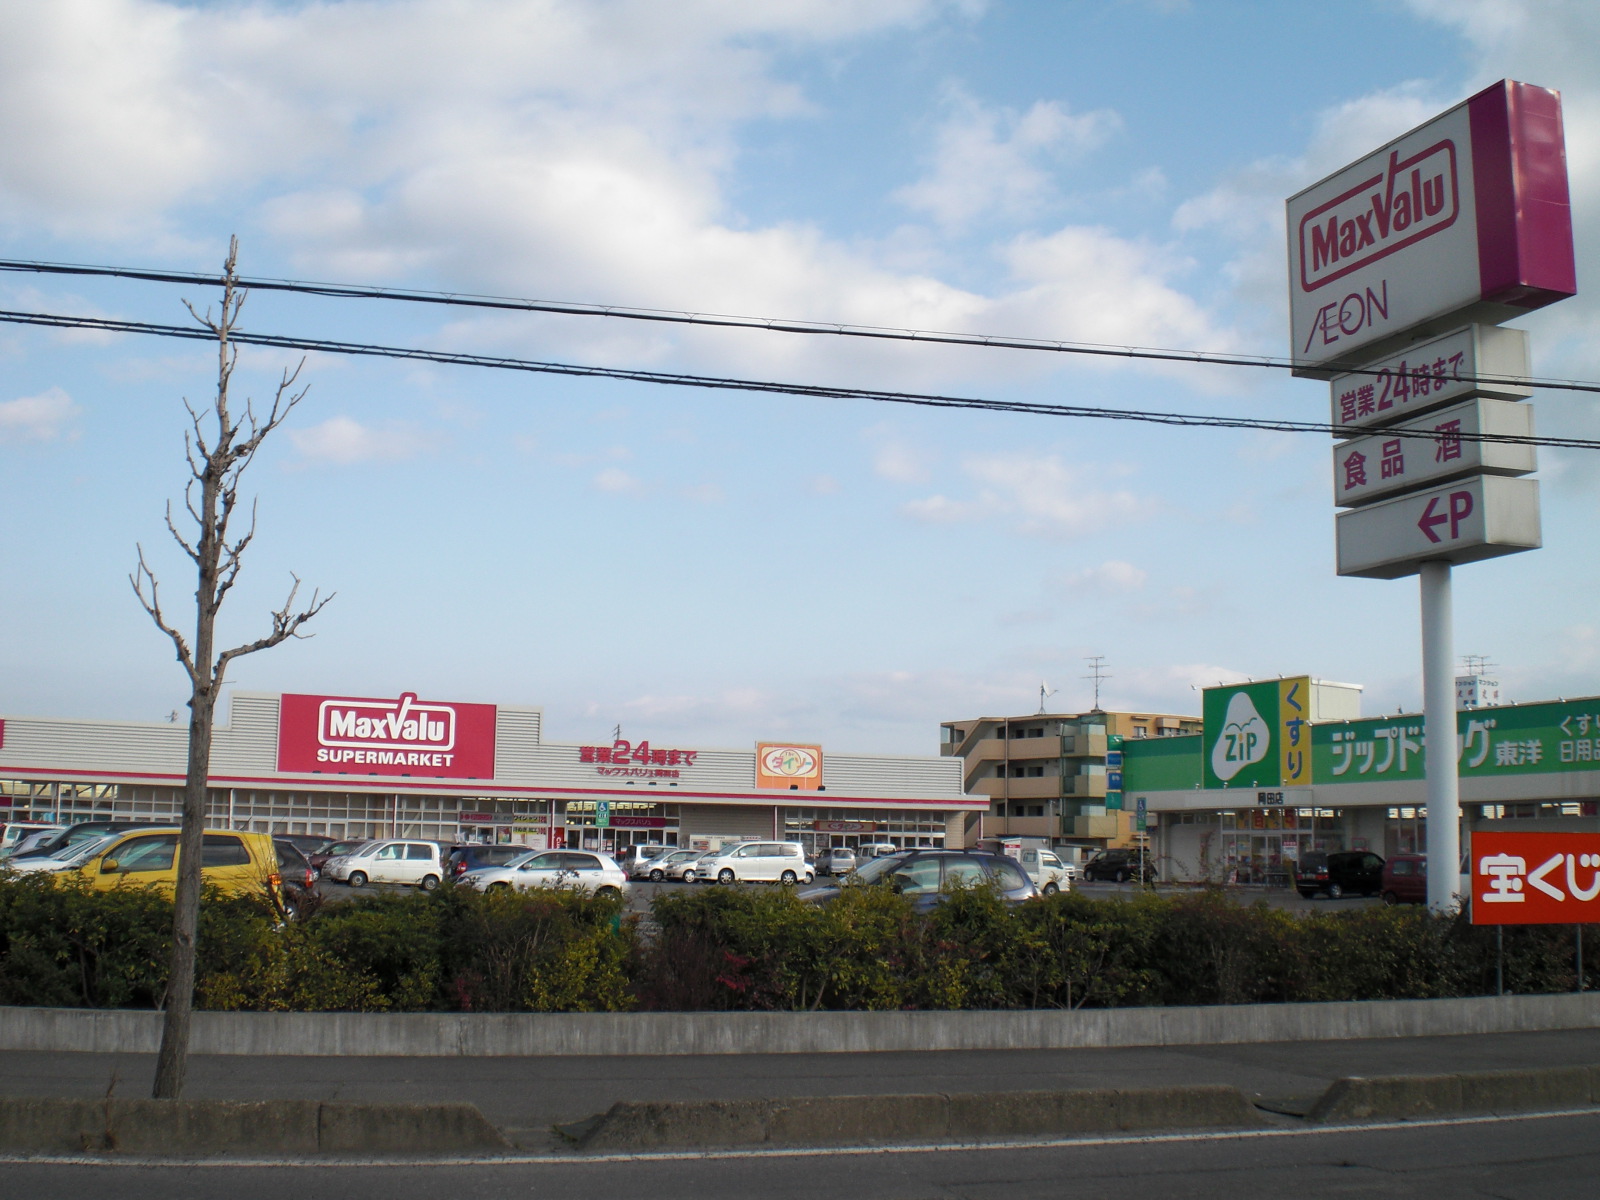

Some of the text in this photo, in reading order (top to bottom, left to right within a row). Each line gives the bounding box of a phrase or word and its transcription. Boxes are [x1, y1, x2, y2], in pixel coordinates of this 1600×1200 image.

[1312, 150, 1446, 271] MaxValu
[1340, 351, 1464, 424] 営業24時まで
[329, 697, 445, 742] MaxValu
[1285, 682, 1304, 780] くすり
[317, 748, 454, 766] SUPERMARKET
[579, 740, 698, 766] 営業24時まで
[772, 756, 812, 769] ダイソー
[1480, 853, 1600, 903] 宝くじ
